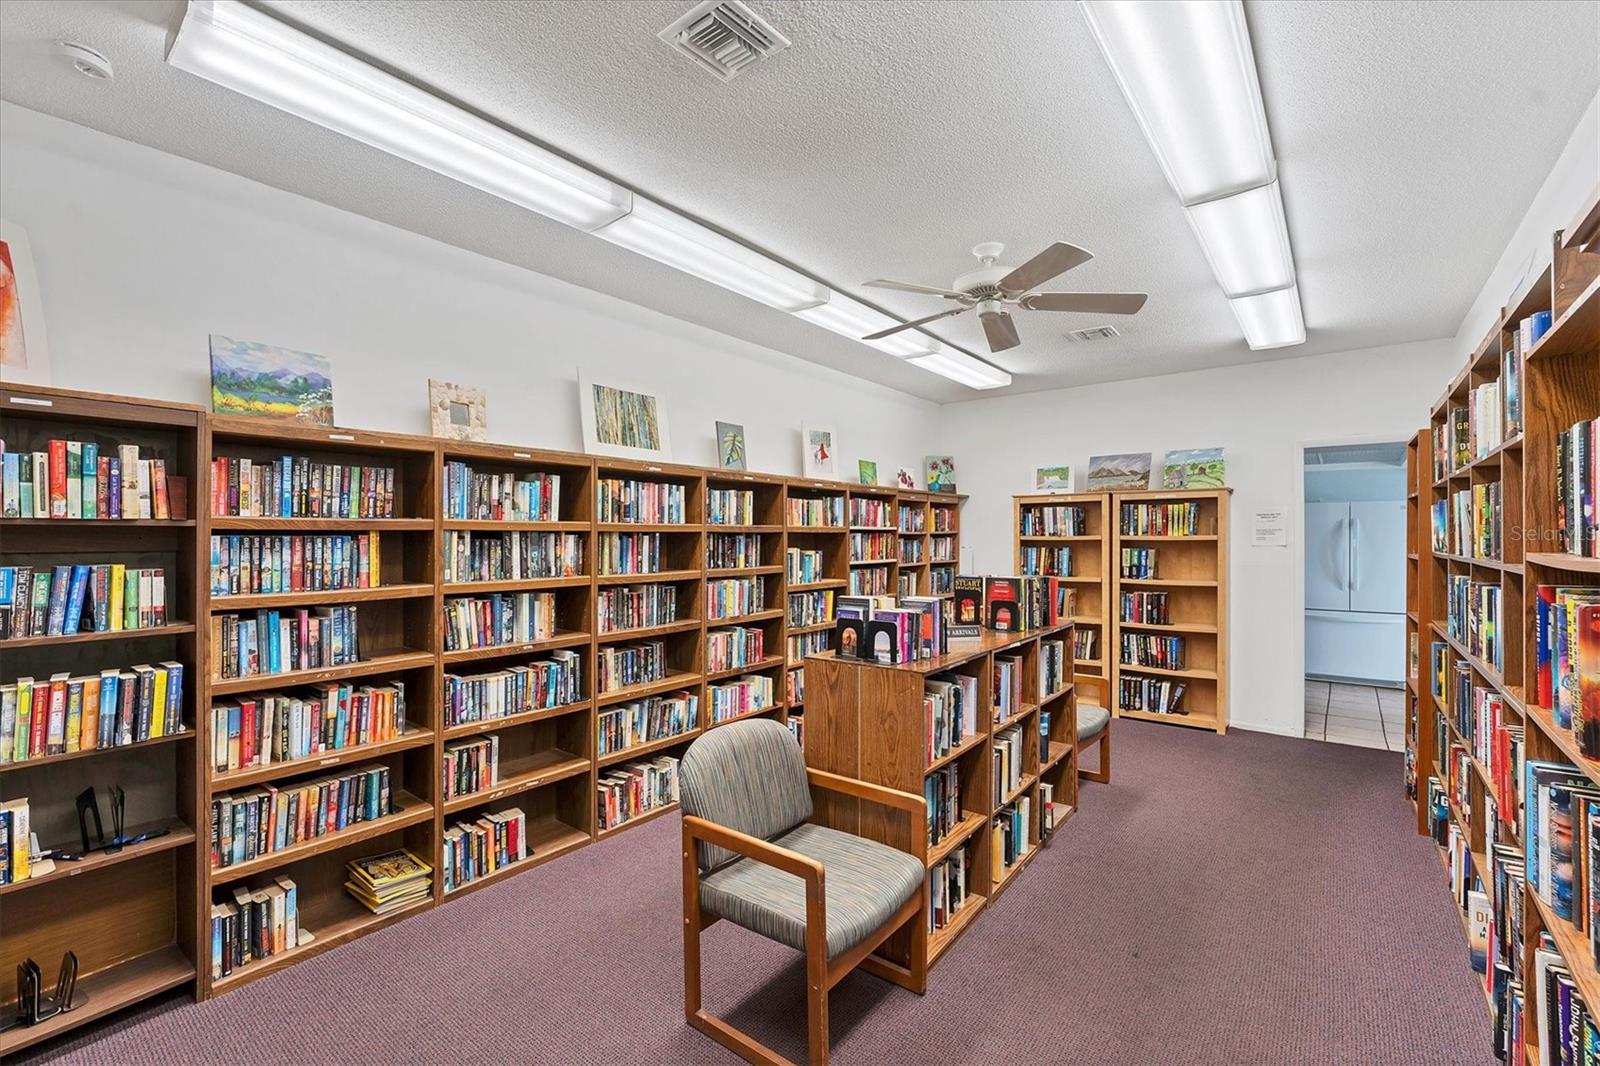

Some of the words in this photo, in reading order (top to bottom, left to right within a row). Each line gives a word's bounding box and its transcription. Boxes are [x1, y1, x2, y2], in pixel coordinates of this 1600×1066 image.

[18, 570, 28, 584] TOM
[16, 585, 26, 609] CLANCY
[1476, 912, 1488, 923] DI
[1569, 998, 1580, 1034] JOHN
[1584, 1020, 1592, 1053] JOHN
